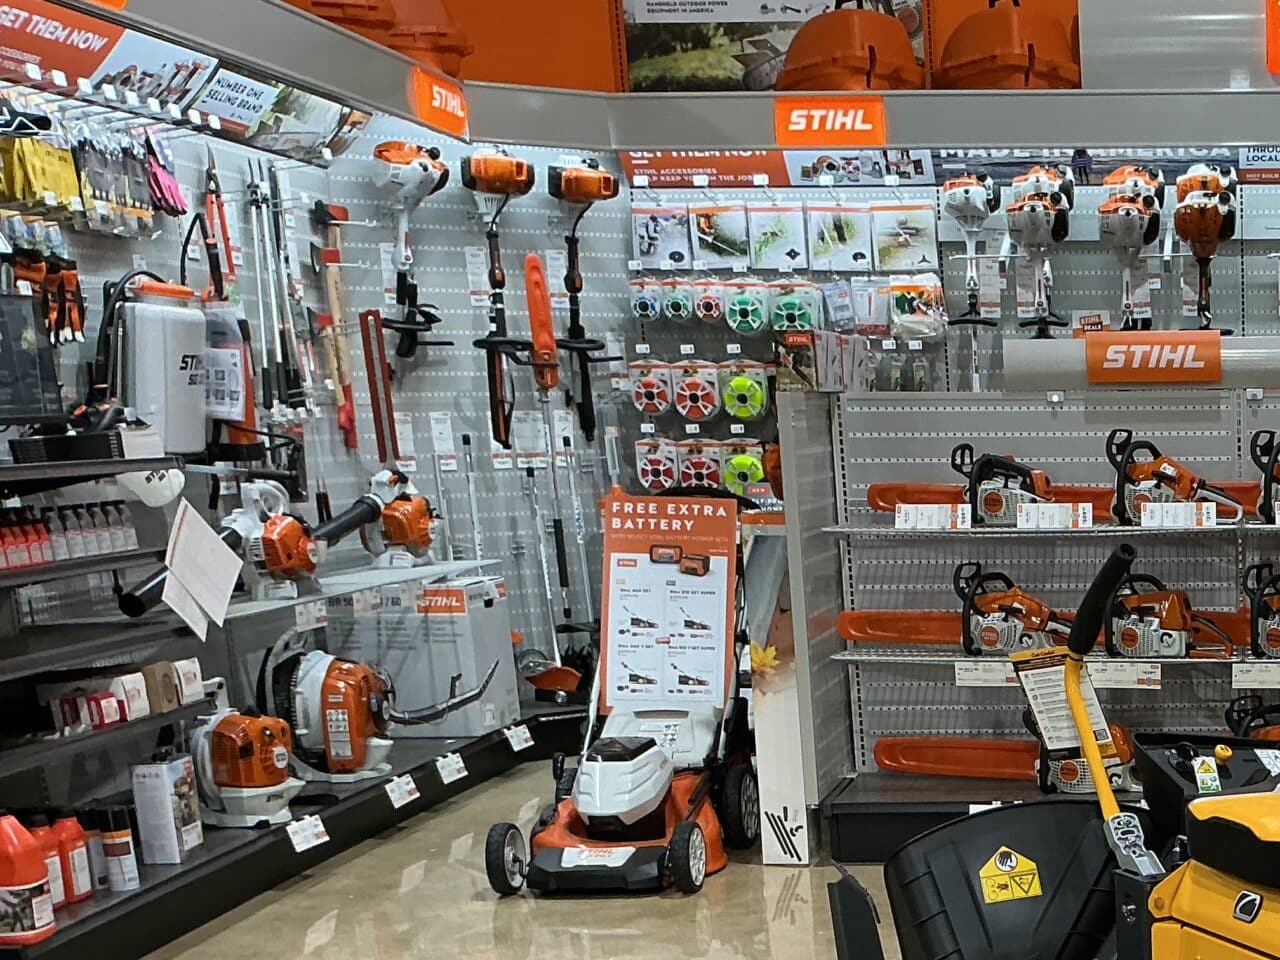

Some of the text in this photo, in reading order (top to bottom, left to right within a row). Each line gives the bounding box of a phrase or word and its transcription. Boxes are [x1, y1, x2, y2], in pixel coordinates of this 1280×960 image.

[25, 14, 69, 42] THEM
[68, 31, 108, 53] NOW
[215, 77, 264, 100] NUMBER ONE
[206, 89, 263, 114] SELLING BRAND
[432, 84, 465, 118] STIHL
[788, 109, 873, 131] STIHL
[1246, 154, 1280, 162] LOCAL
[660, 167, 718, 175] ACCESSORIES
[1079, 315, 1101, 326] STIHL
[1102, 344, 1206, 369] STIHL
[612, 501, 728, 517] FREE EXTRA
[611, 517, 695, 531] BATTERY
[419, 596, 462, 607] STIHL
